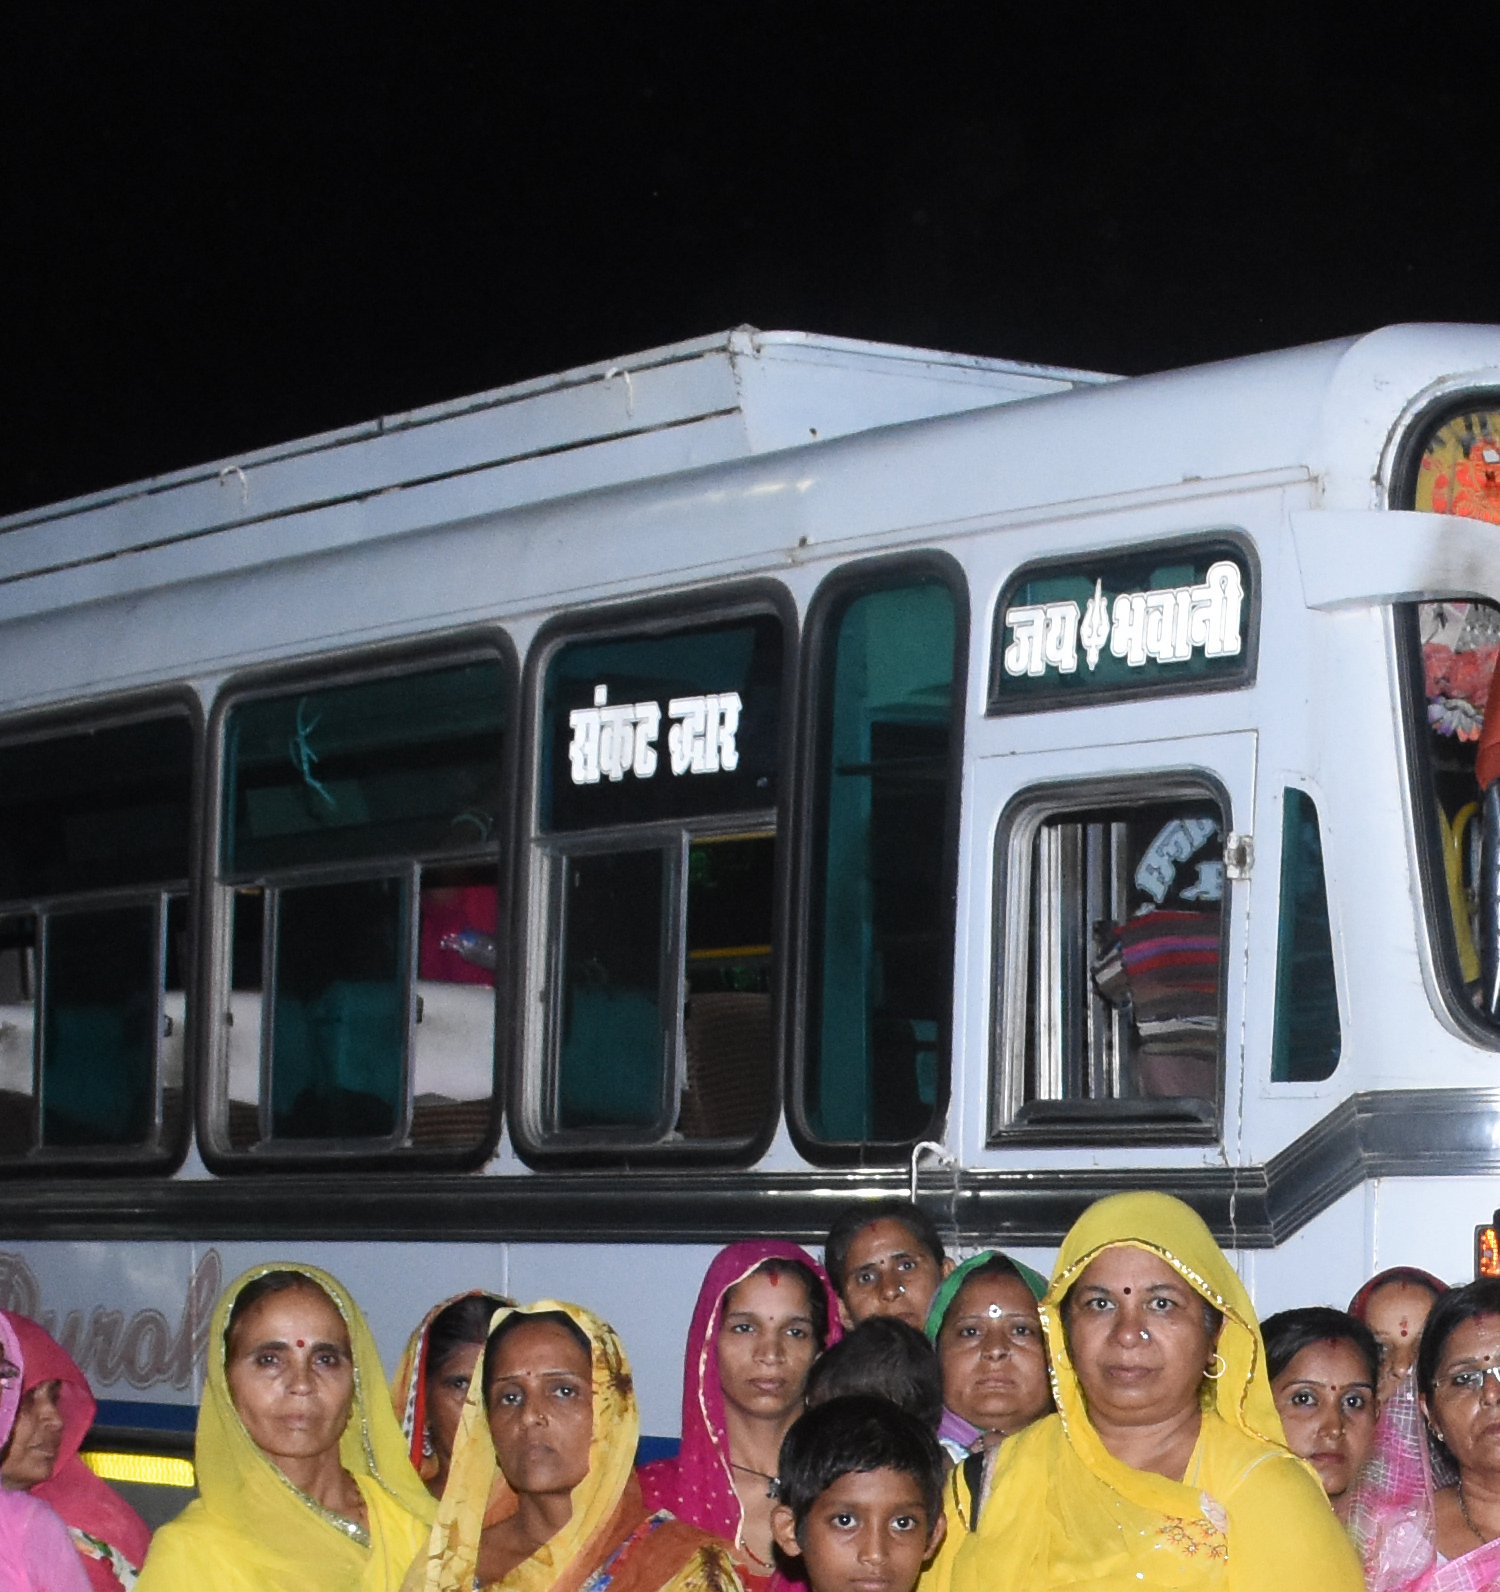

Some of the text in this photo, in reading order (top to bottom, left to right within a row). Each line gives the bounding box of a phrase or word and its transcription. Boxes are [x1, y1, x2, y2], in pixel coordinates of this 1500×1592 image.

[1005, 560, 1244, 677] जय भवानी
[568, 684, 661, 785] संकट
